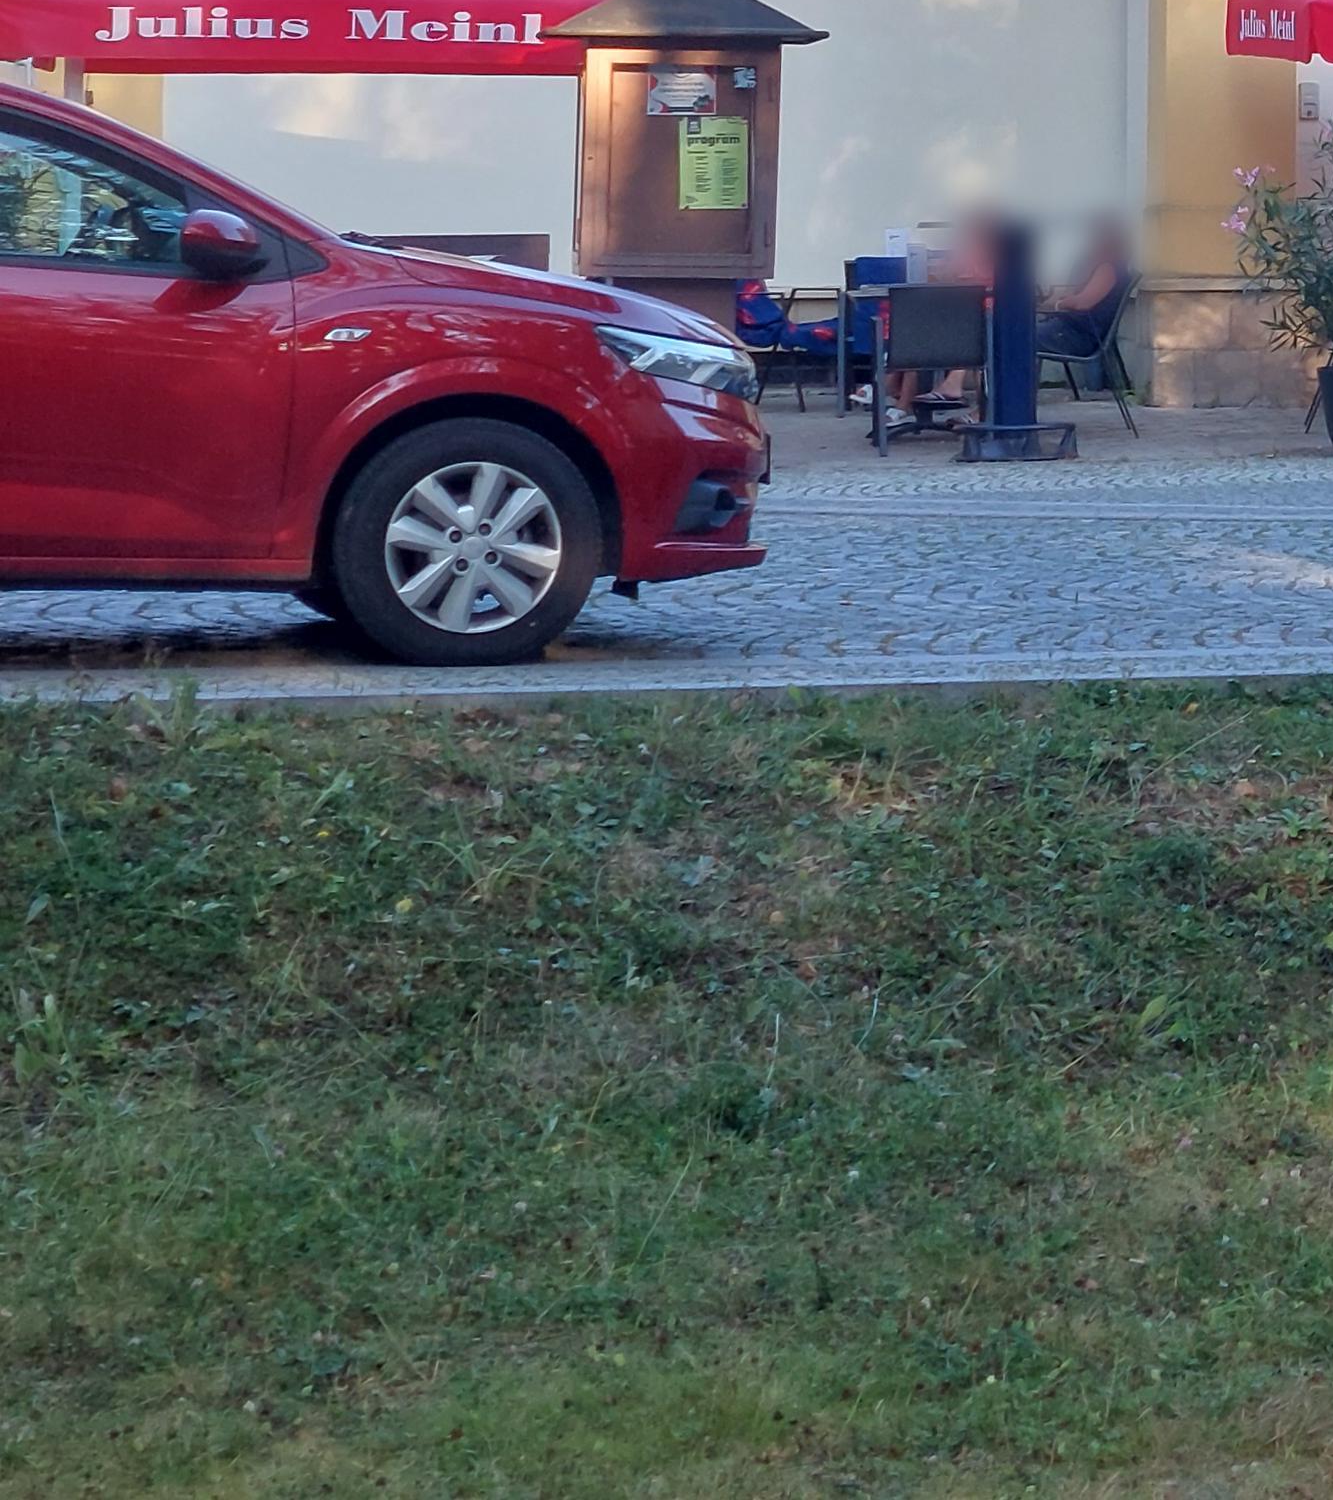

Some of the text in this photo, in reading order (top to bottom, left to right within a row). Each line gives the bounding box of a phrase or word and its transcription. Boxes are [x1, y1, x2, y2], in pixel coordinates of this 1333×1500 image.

[95, 6, 546, 45] Julius Meinl
[1239, 8, 1296, 42] Julius Meinl
[686, 134, 741, 147] program
